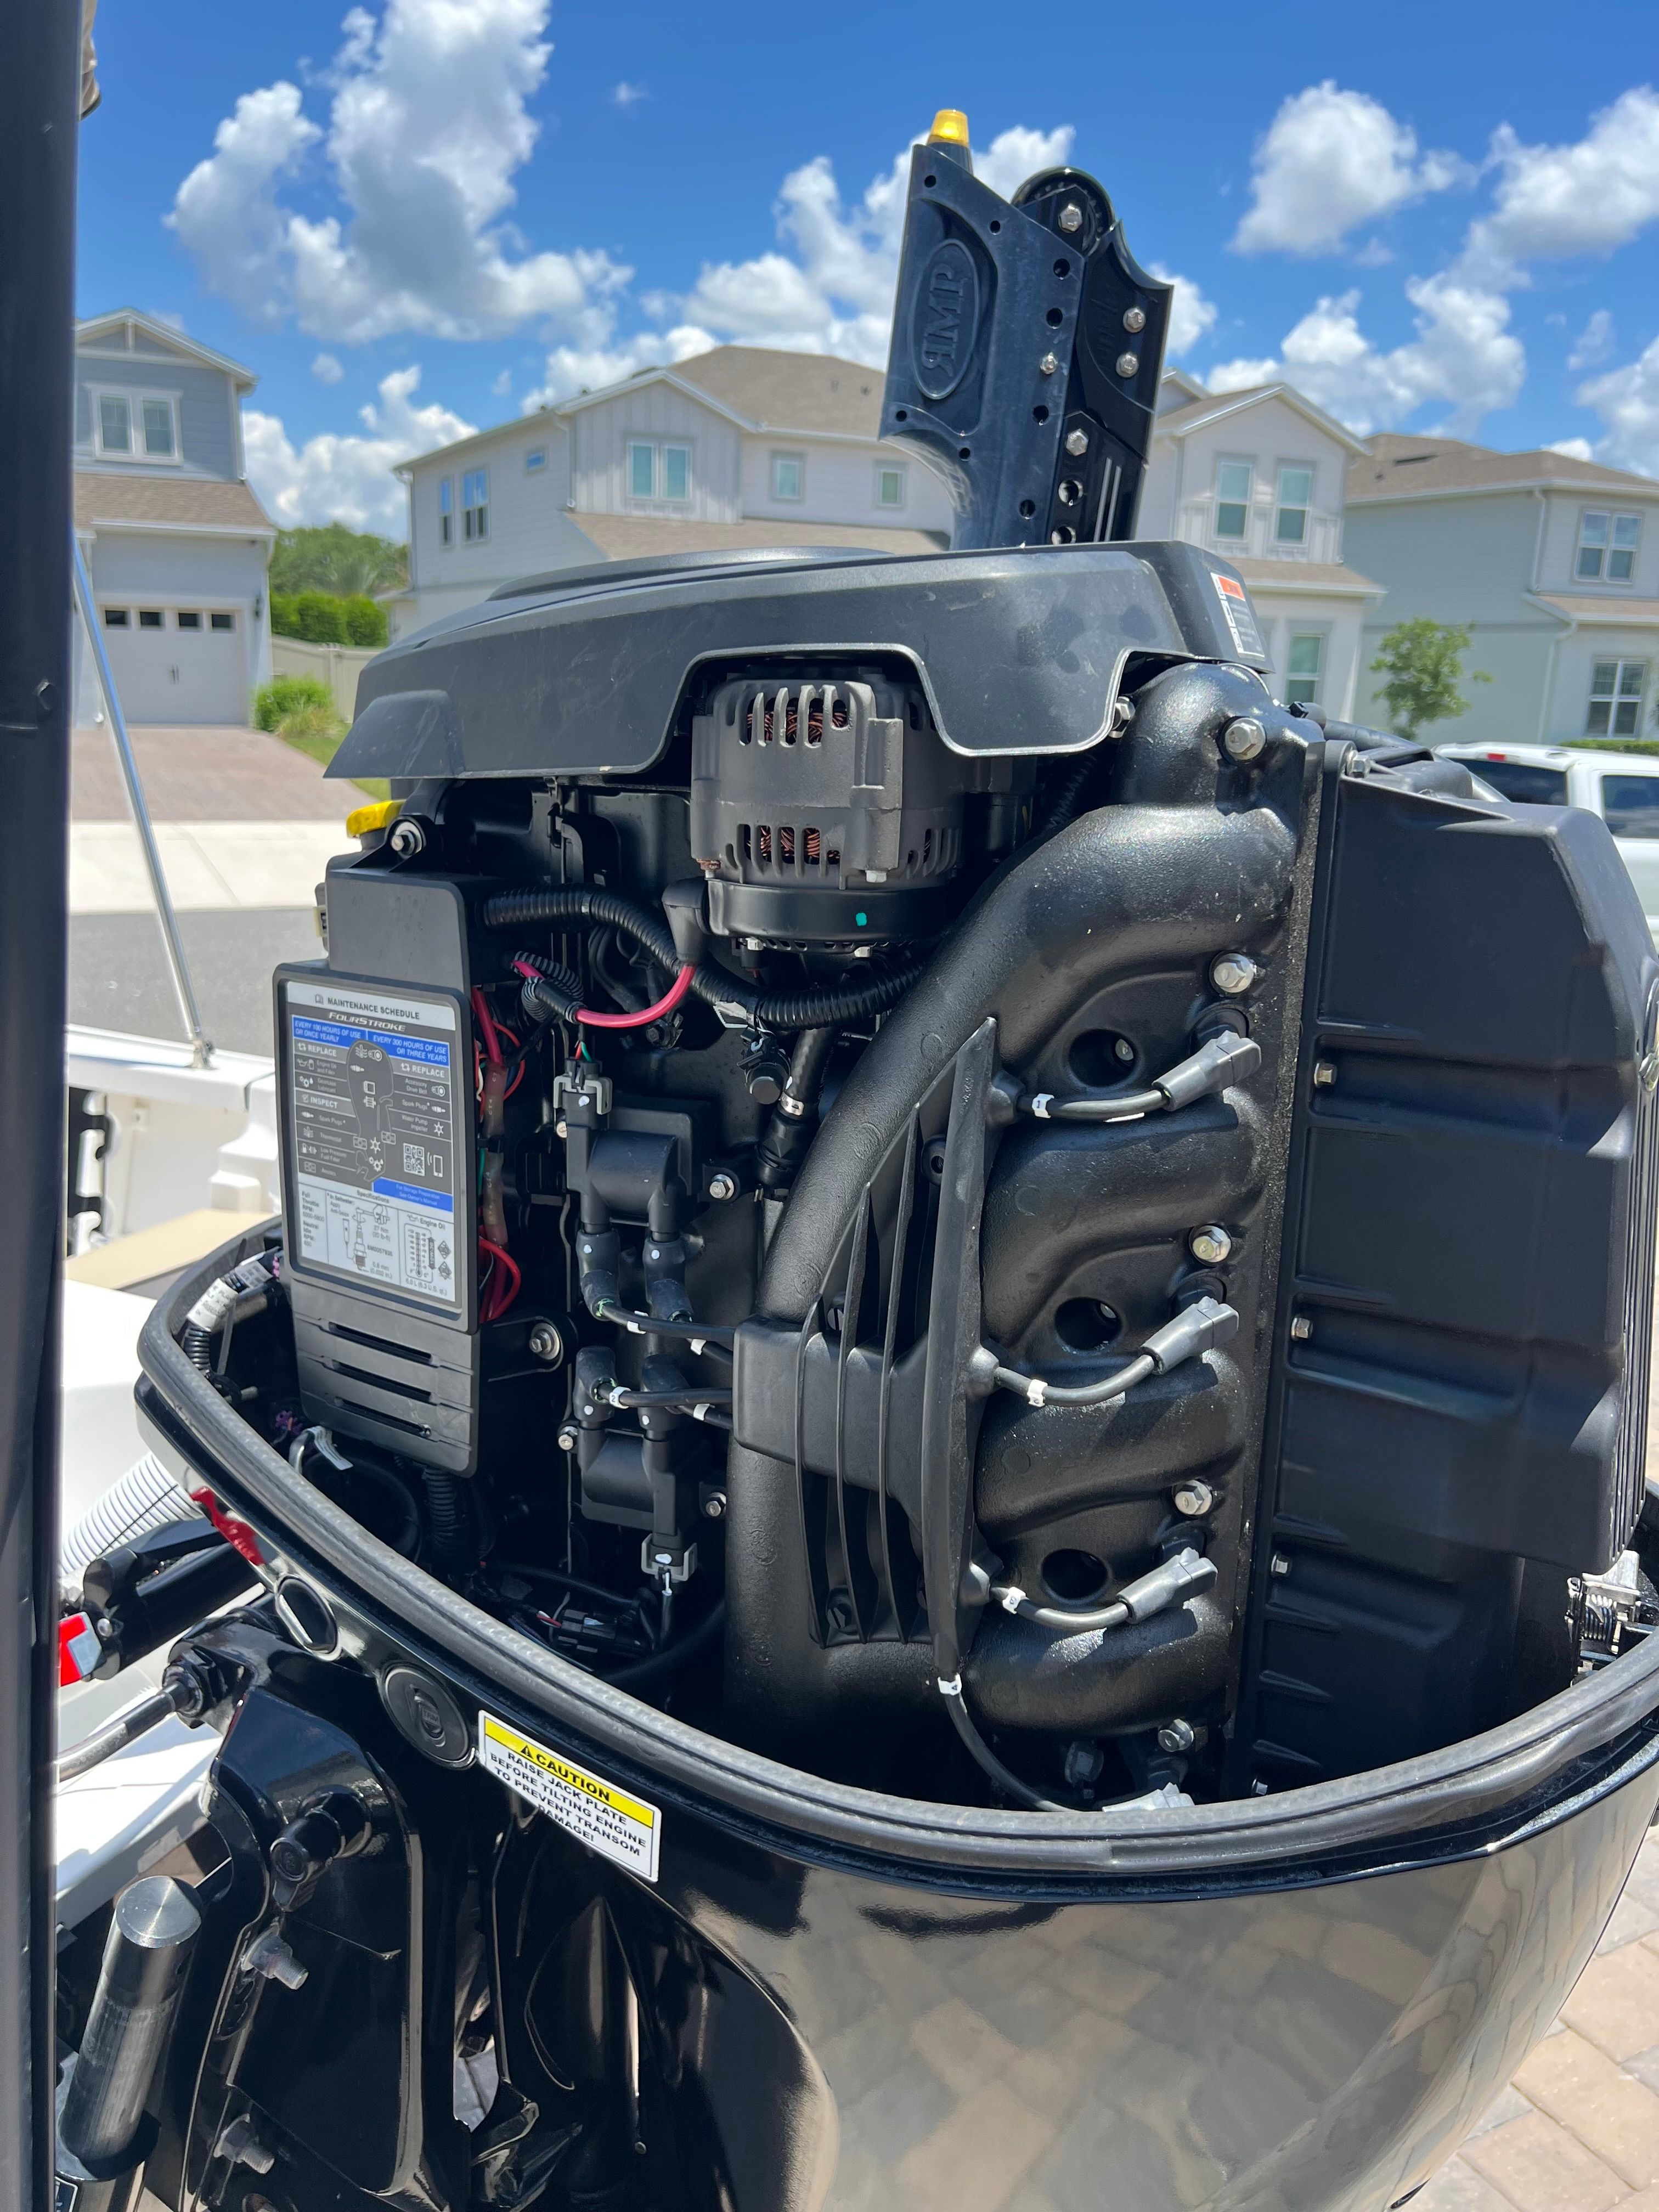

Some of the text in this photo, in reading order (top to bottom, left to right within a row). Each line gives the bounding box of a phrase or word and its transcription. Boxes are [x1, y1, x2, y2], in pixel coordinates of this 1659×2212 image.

[328, 997, 420, 1019] MAINTENANCE SCHEDULE
[304, 1030, 318, 1039] ONCE
[320, 1033, 340, 1043] YEARLY
[322, 1025, 340, 1035] HOURS
[373, 1035, 392, 1045] EVERY
[403, 1040, 424, 1051] HOURS
[308, 1045, 337, 1057] REPLACE
[406, 1049, 426, 1059] THREE
[427, 1053, 447, 1063] YEARS
[412, 1065, 445, 1078] REPLACE
[405, 1078, 427, 1088] Accessory
[310, 1096, 338, 1109] INSPECT
[402, 1099, 414, 1107] Spark
[415, 1118, 428, 1126] Pump
[357, 1189, 390, 1204] Specifications
[403, 1186, 418, 1195] Storage
[423, 1197, 438, 1206] Manual
[303, 1220, 319, 1229] Neutral
[420, 1218, 437, 1227] Engine
[611, 1395, 616, 1403] 2
[536, 1753, 610, 1802] CAUTION
[507, 1751, 628, 1825] RAISE JACK PLATE
[490, 1752, 647, 1847] BEFORE TILTING ENGINE
[494, 1767, 640, 1857] TO PREVENT TRANSOM
[538, 1804, 595, 1842] DAMAGE!
